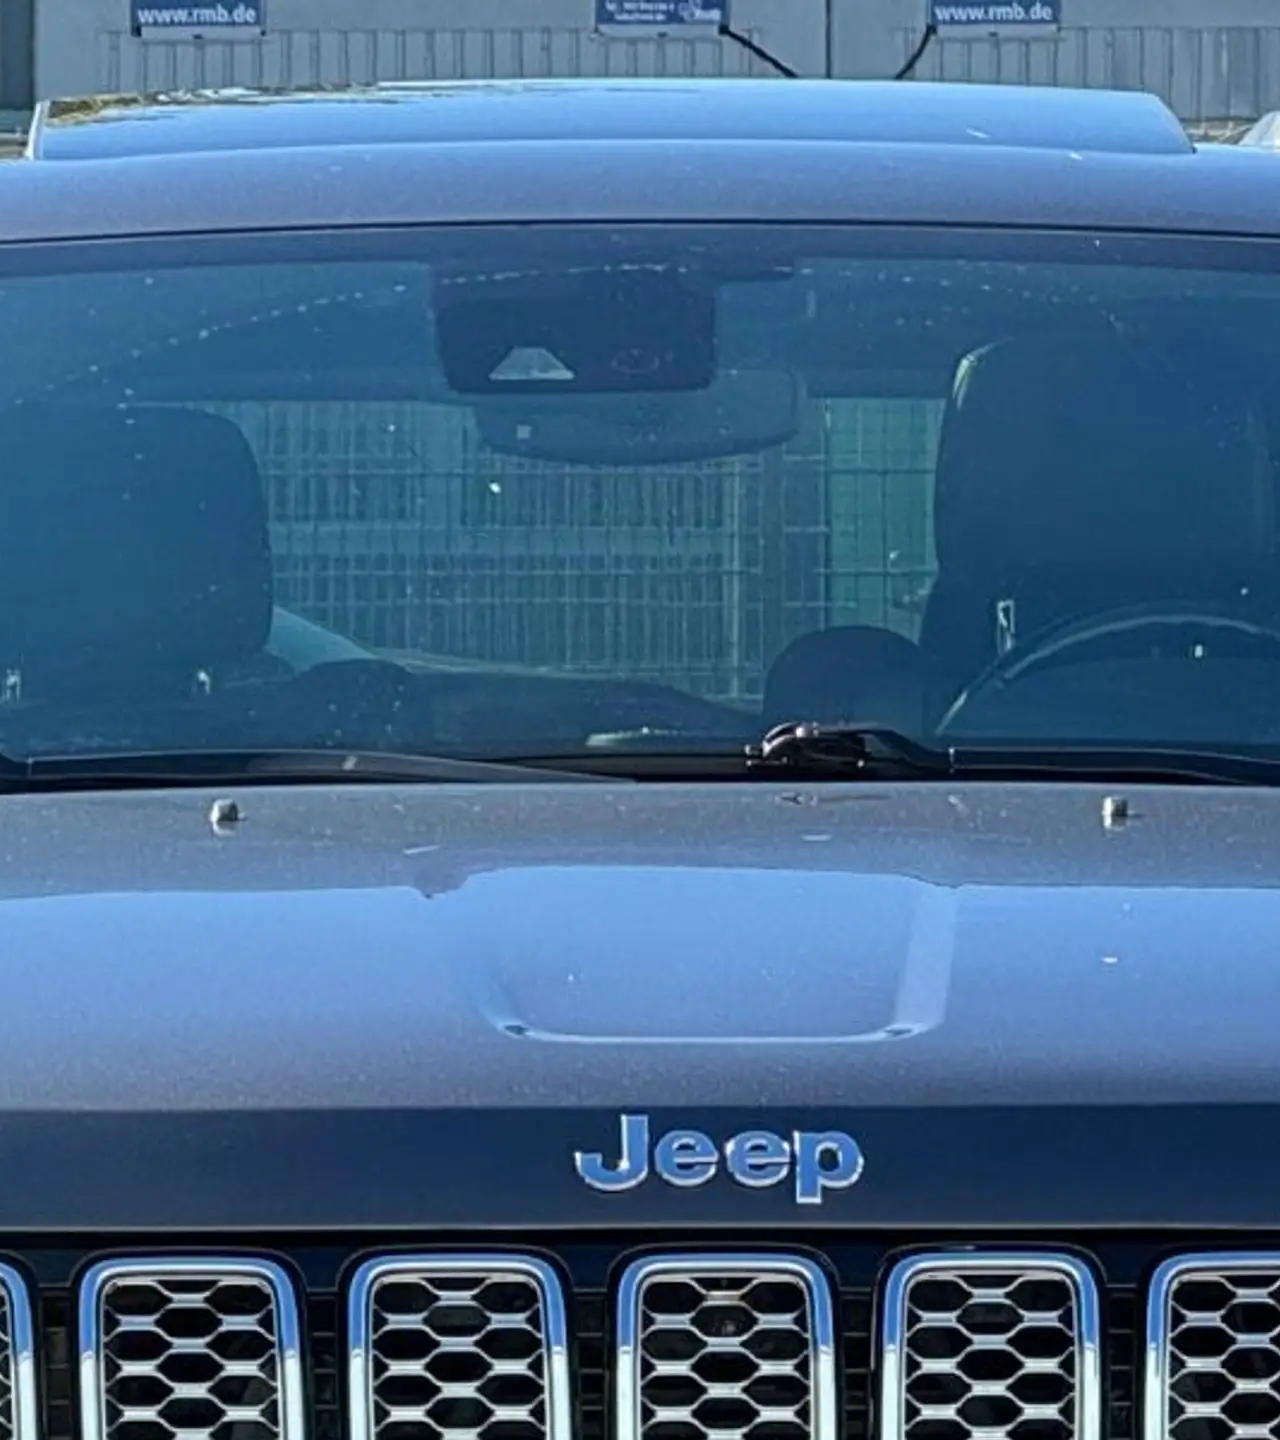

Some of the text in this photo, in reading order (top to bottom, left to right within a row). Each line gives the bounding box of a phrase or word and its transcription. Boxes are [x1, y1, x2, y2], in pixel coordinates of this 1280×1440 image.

[137, 3, 256, 24] www.rmb.de
[933, 1, 1052, 21] www.rmb.de
[574, 1114, 864, 1204] Jeep
